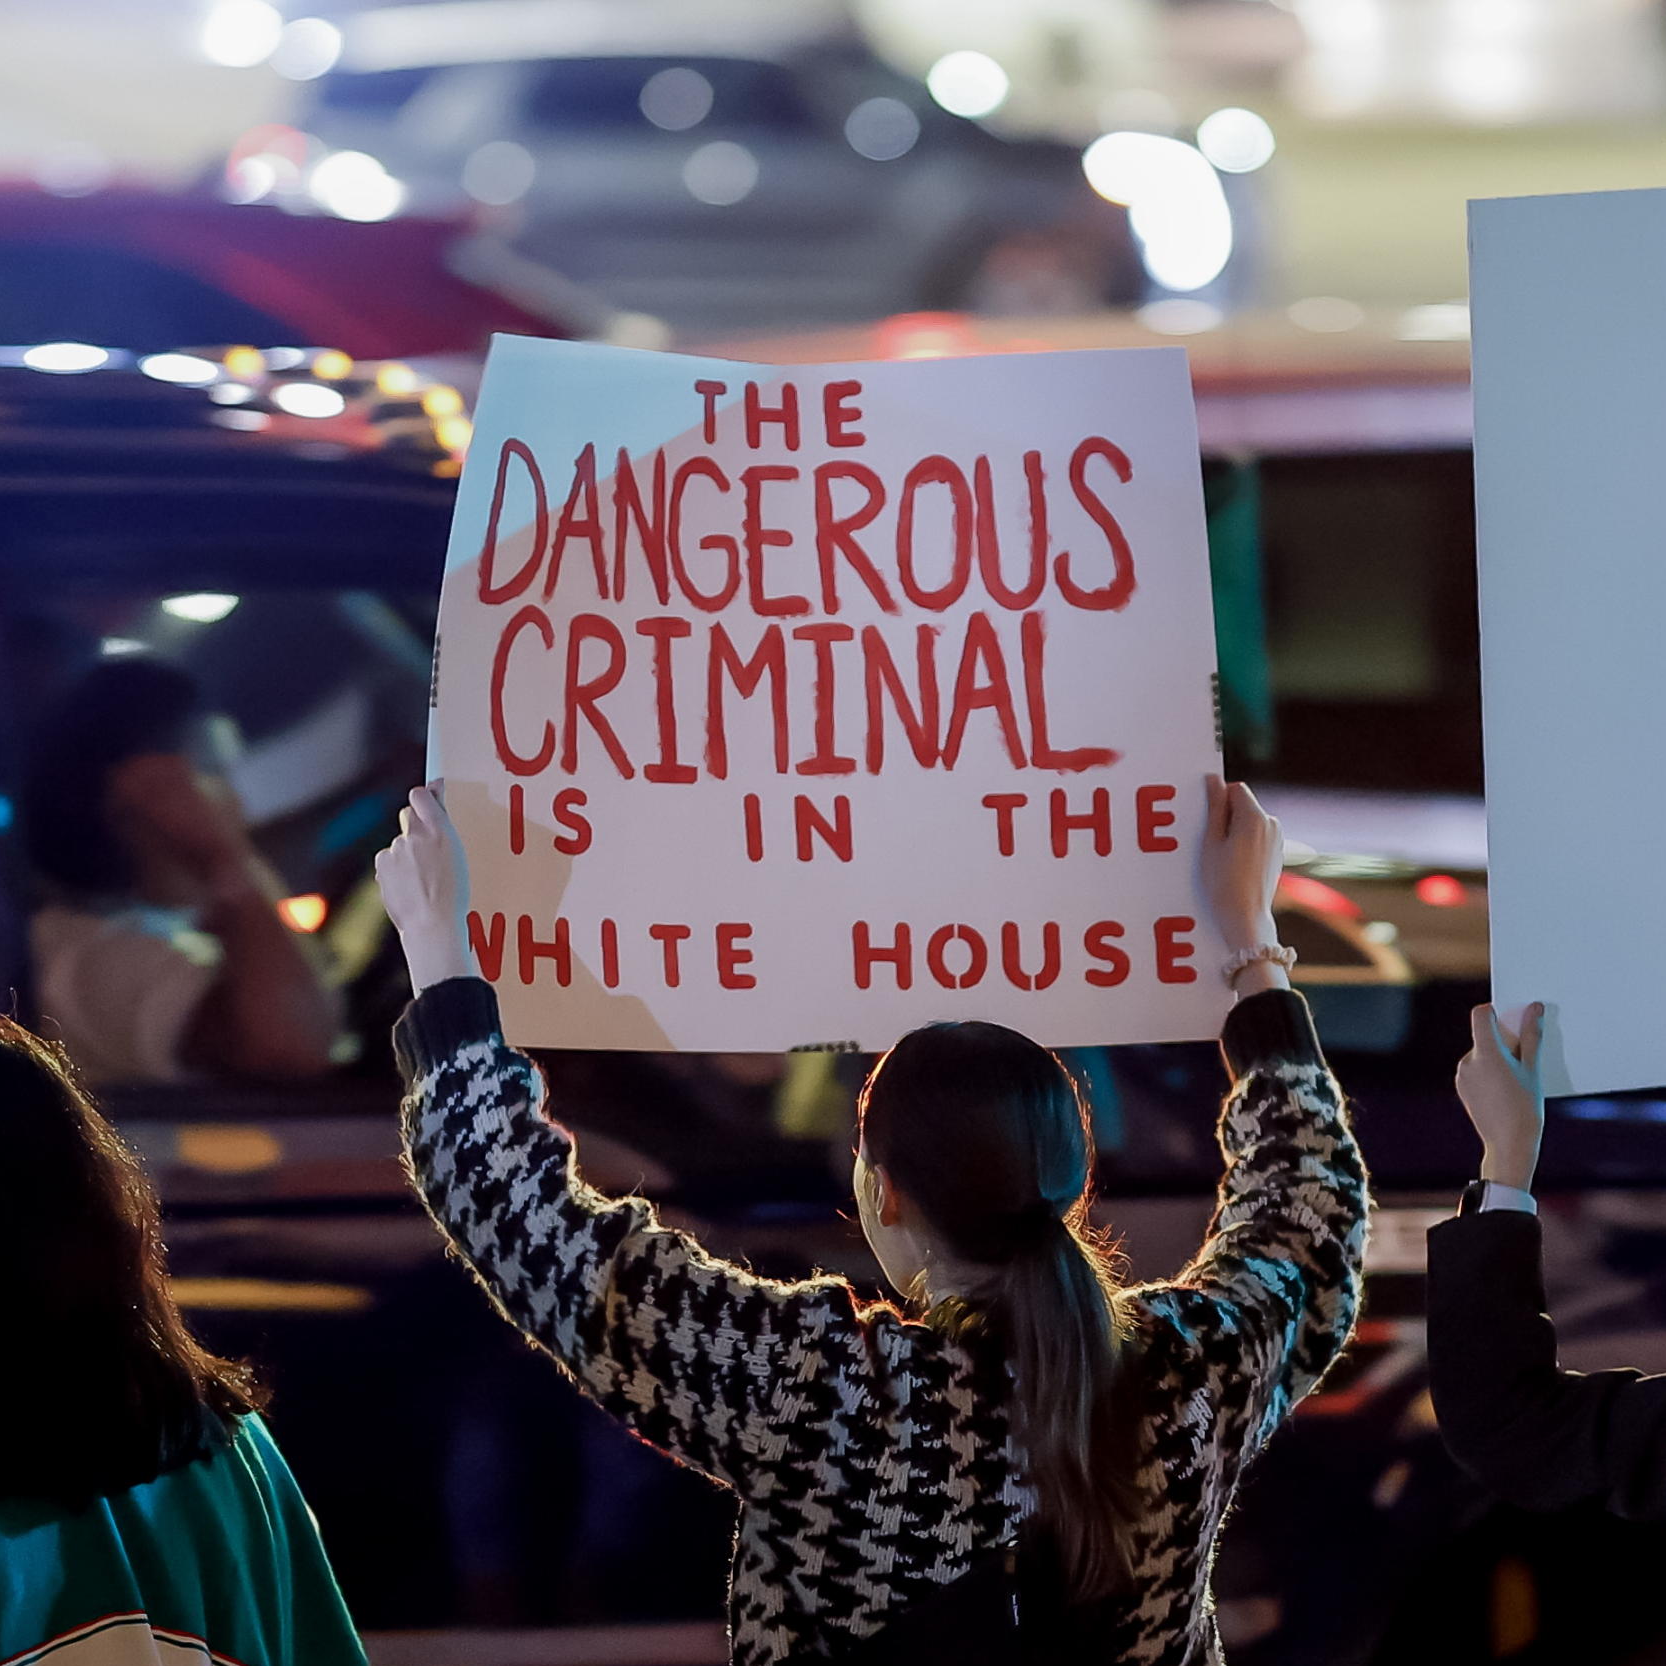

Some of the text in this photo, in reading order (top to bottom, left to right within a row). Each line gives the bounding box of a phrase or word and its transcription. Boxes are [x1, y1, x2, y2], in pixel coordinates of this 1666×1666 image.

[695, 380, 867, 451] THE
[478, 436, 1136, 618] DANGEROUS
[489, 605, 1123, 784] CRIMINAL
[509, 784, 1179, 863] IS IN THE
[851, 915, 1199, 992] HOUSE
